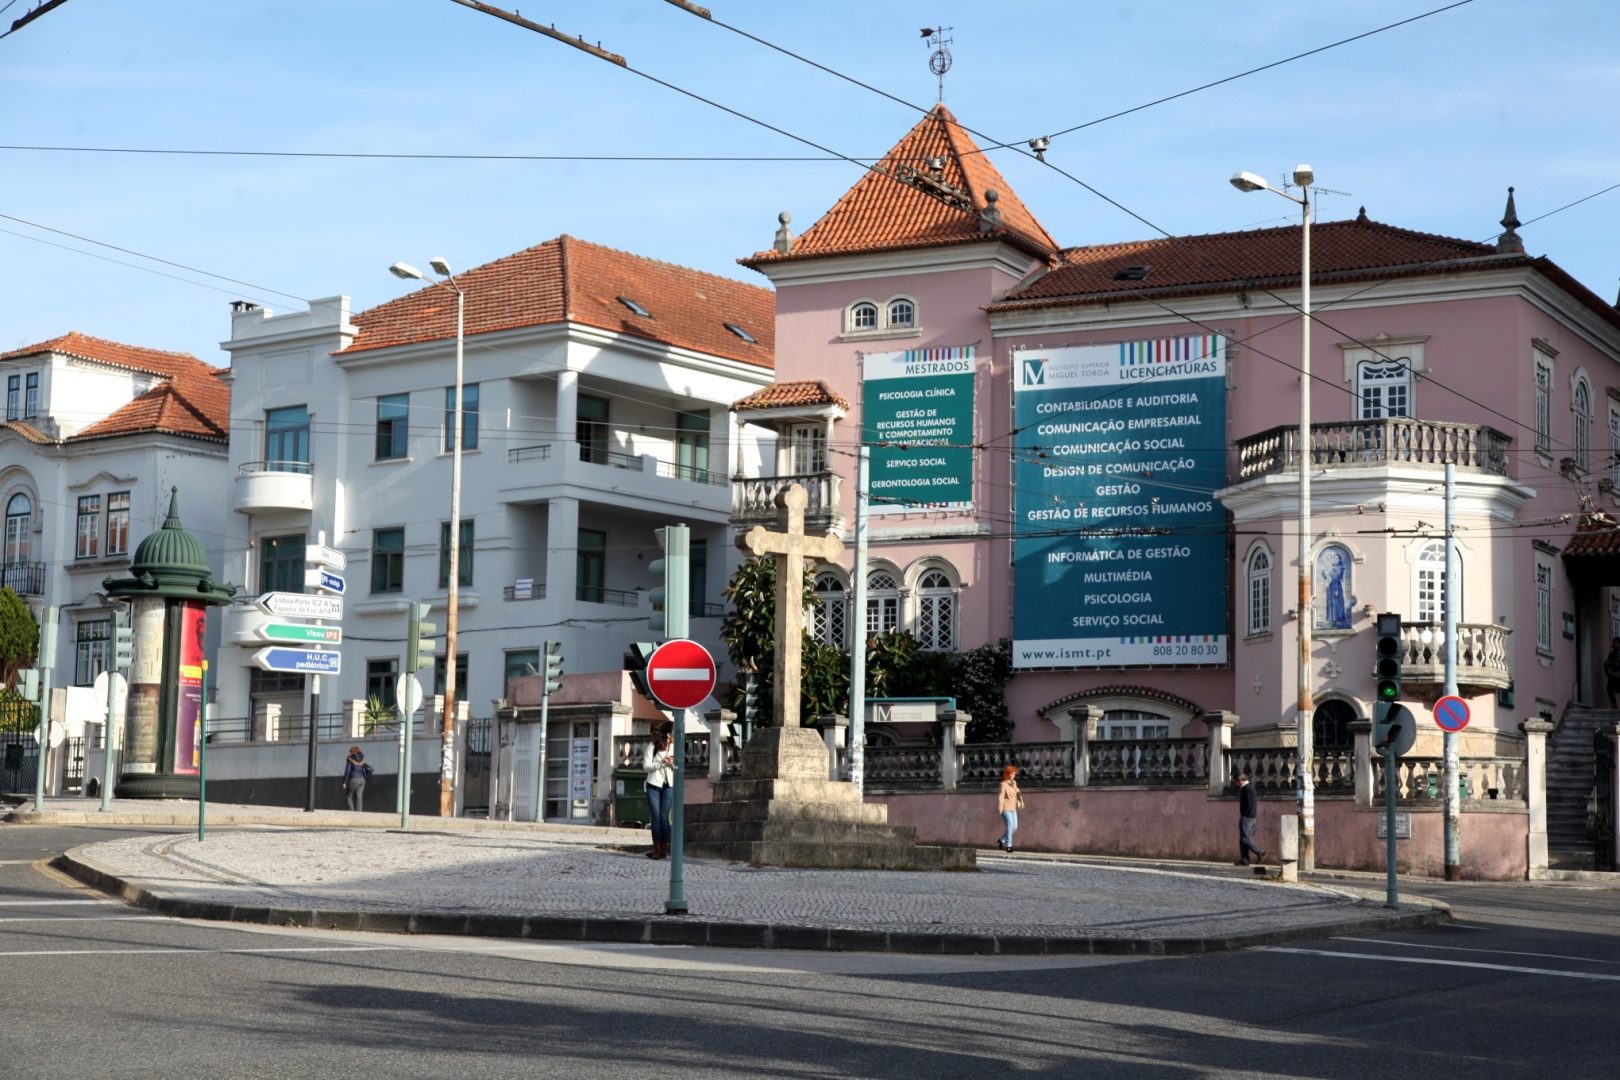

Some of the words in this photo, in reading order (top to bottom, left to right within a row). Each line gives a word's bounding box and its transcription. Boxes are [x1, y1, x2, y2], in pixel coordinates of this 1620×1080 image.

[906, 361, 969, 374] MESTRADOS
[1120, 361, 1217, 380] LICENCIATURAS
[1049, 371, 1078, 379] MIGUEL
[879, 391, 923, 400] PSICOLOGIA
[925, 388, 955, 396] CLÍNICA
[1036, 398, 1123, 413] CONTABILIDADE
[1127, 398, 1132, 408] E
[1136, 393, 1198, 407] AUDITORIA
[896, 408, 925, 418] GESTÃO
[877, 421, 914, 429] RECURSOS
[917, 418, 955, 426] HUMANOS
[1038, 419, 1124, 435] COMUNICAÇÃO
[1128, 415, 1201, 429] EMPRESARIAL
[886, 428, 953, 438] COMPORTAMENTO
[1053, 440, 1140, 456] COMUNICAÇÃO
[1144, 439, 1184, 449] SOCIAL
[887, 460, 918, 469] SERVIÇO
[920, 458, 946, 466] SOCIAL
[1044, 466, 1084, 477] DESIGN
[1089, 465, 1102, 475] DE
[1106, 458, 1195, 474] COMUNICAÇÃO
[872, 479, 930, 488] GERONTOLOGIA
[932, 477, 959, 485] SOCIAL
[1096, 482, 1141, 495] GESTÃO
[1028, 506, 1071, 520] GESTÃO
[1074, 508, 1088, 518] DE
[1091, 505, 1148, 518] RECURSOS
[1152, 501, 1212, 515] HUMANOS
[1048, 548, 1124, 563] INFORMÁTICA
[1128, 549, 1141, 559] DE
[1145, 546, 1190, 558] GESTÃO
[1084, 568, 1152, 583] MULTIMÉDIA
[1084, 593, 1152, 605] PSICOLOGIA
[1072, 615, 1120, 628] SERVIÇO
[1123, 614, 1164, 626] SOCIAL
[305, 630, 325, 638] Viseu
[326, 631, 337, 639] IP3
[1022, 647, 1112, 663] www.ismt.pt
[1153, 646, 1172, 656] 808
[1176, 646, 1188, 656] 20
[1191, 646, 1203, 655] 80
[1206, 645, 1218, 655] 30
[296, 661, 329, 669] pediátrico
